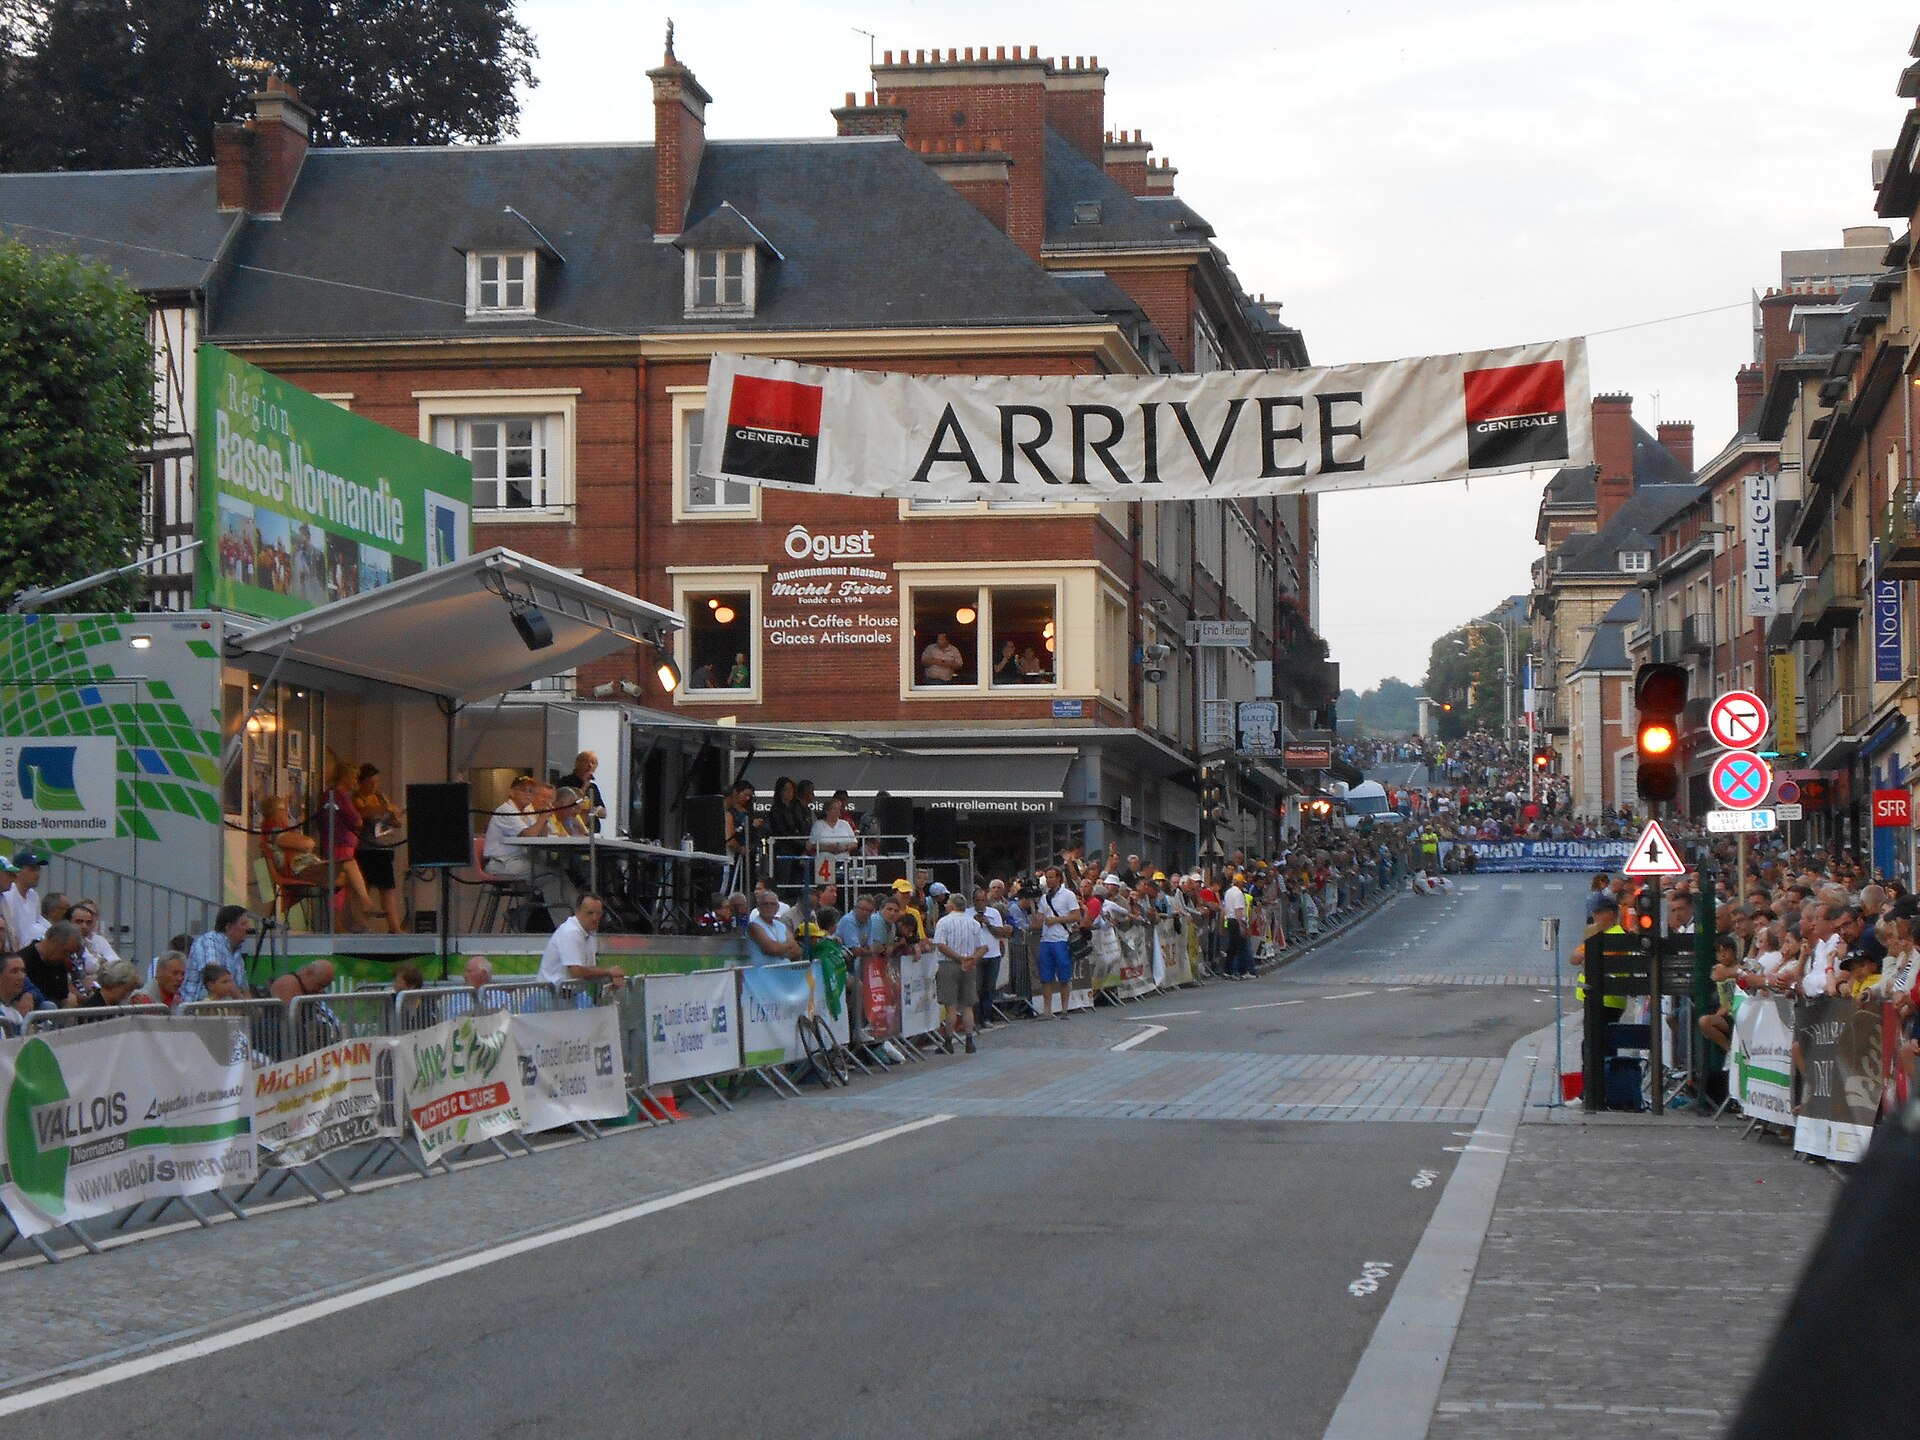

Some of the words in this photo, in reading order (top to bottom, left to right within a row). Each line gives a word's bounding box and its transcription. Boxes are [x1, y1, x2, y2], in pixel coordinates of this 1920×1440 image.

[228, 373, 289, 436] Région
[1476, 415, 1559, 433] GENERALE
[735, 429, 810, 448] GENERALE
[910, 392, 1366, 485] ARRIVEE
[216, 408, 404, 545] Basse-Normandie
[785, 524, 875, 561] Ôgust
[771, 582, 833, 596] Michel
[838, 581, 893, 596] Frères
[763, 615, 799, 629] Lunch
[808, 614, 853, 628] Coffee
[858, 614, 899, 627] House
[770, 631, 815, 645] Glaces
[820, 630, 892, 644] Artisanales
[1021, 802, 1045, 811] bon
[1878, 800, 1907, 817] SFR
[1, 818, 107, 829] Basse-Normandie
[1472, 842, 1525, 858] MARY
[819, 860, 830, 880] 4
[255, 1057, 318, 1098] Michel
[36, 1091, 128, 1146] VALLOIS
[73, 1138, 126, 1160] Normandie
